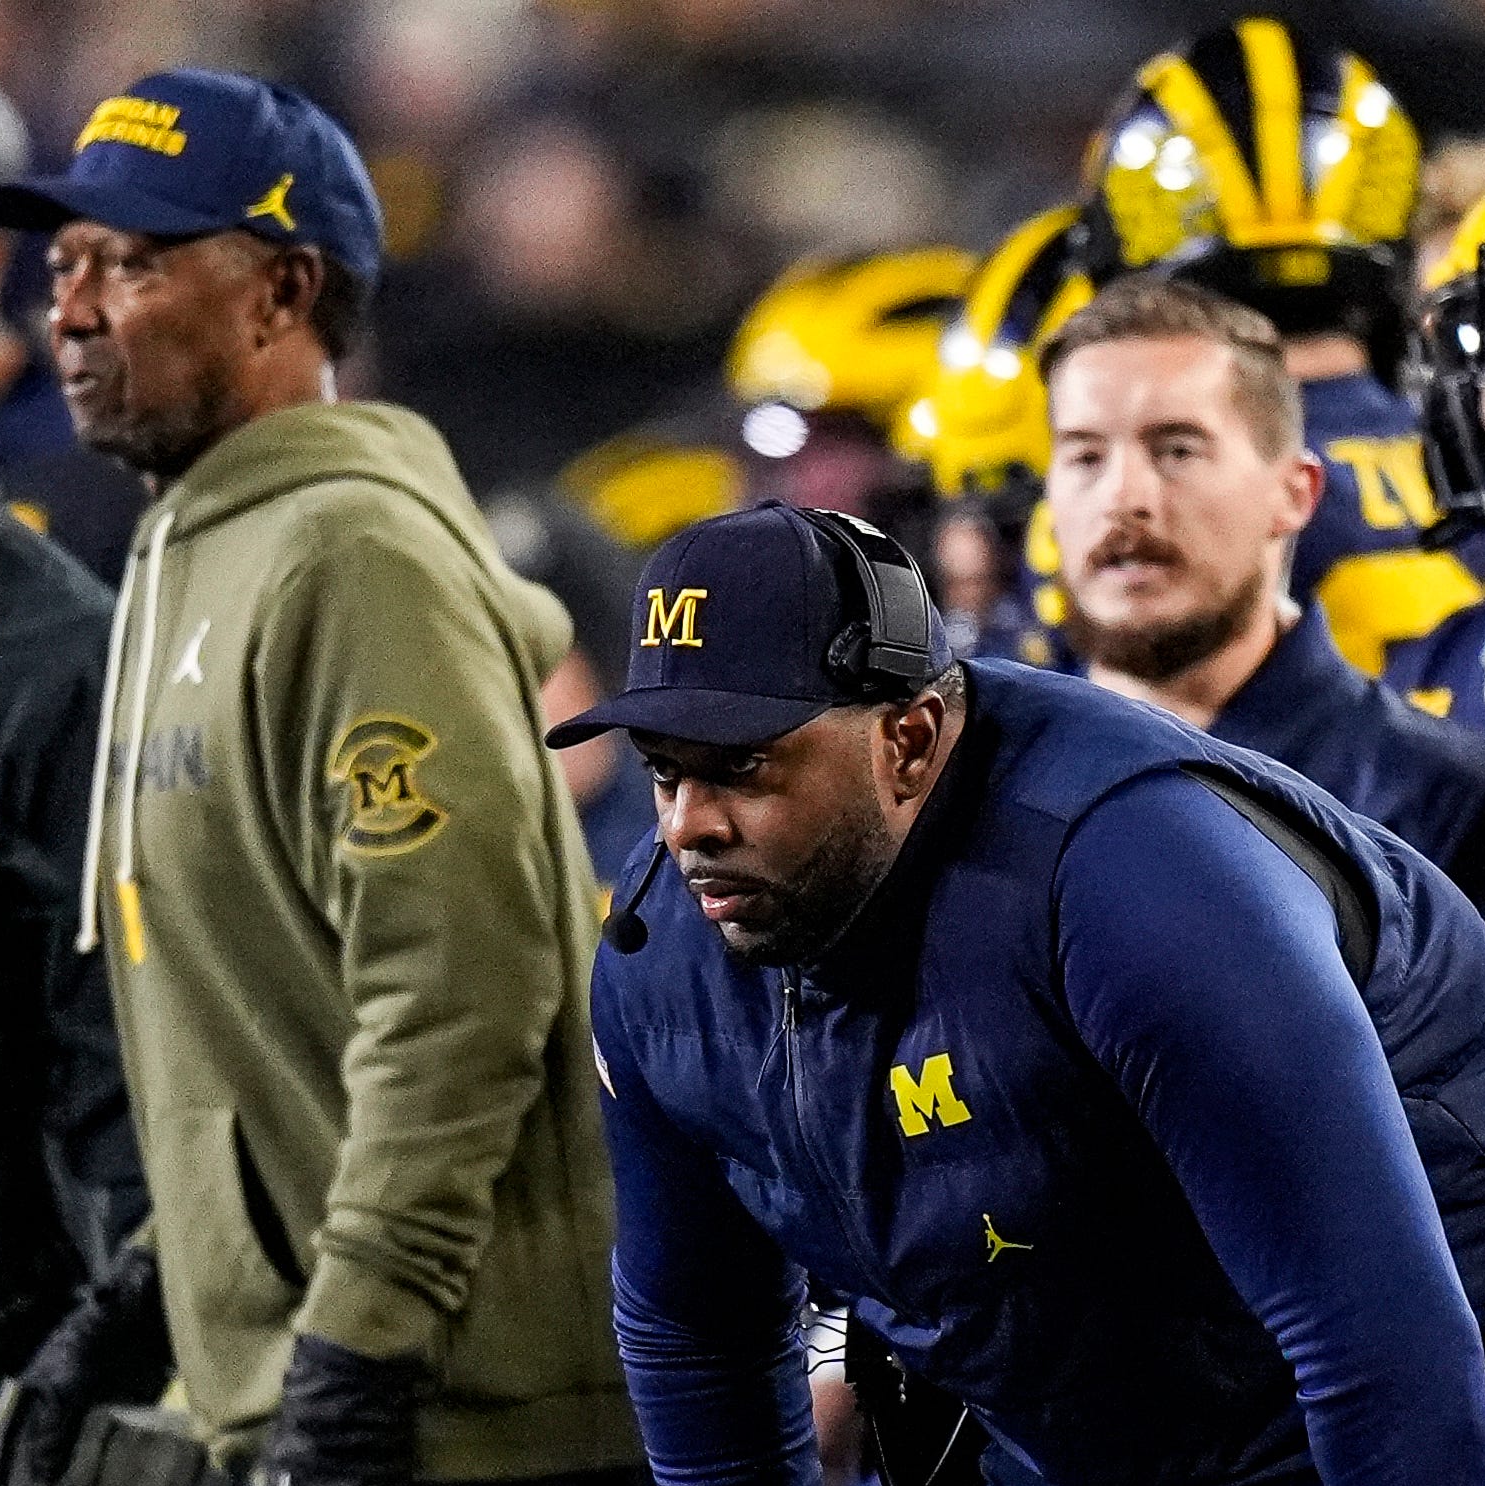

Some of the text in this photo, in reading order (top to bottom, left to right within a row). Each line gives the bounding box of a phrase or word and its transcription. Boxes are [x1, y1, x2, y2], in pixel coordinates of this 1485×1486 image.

[640, 588, 707, 647] M
[354, 762, 410, 810] M
[890, 1053, 972, 1137] M
